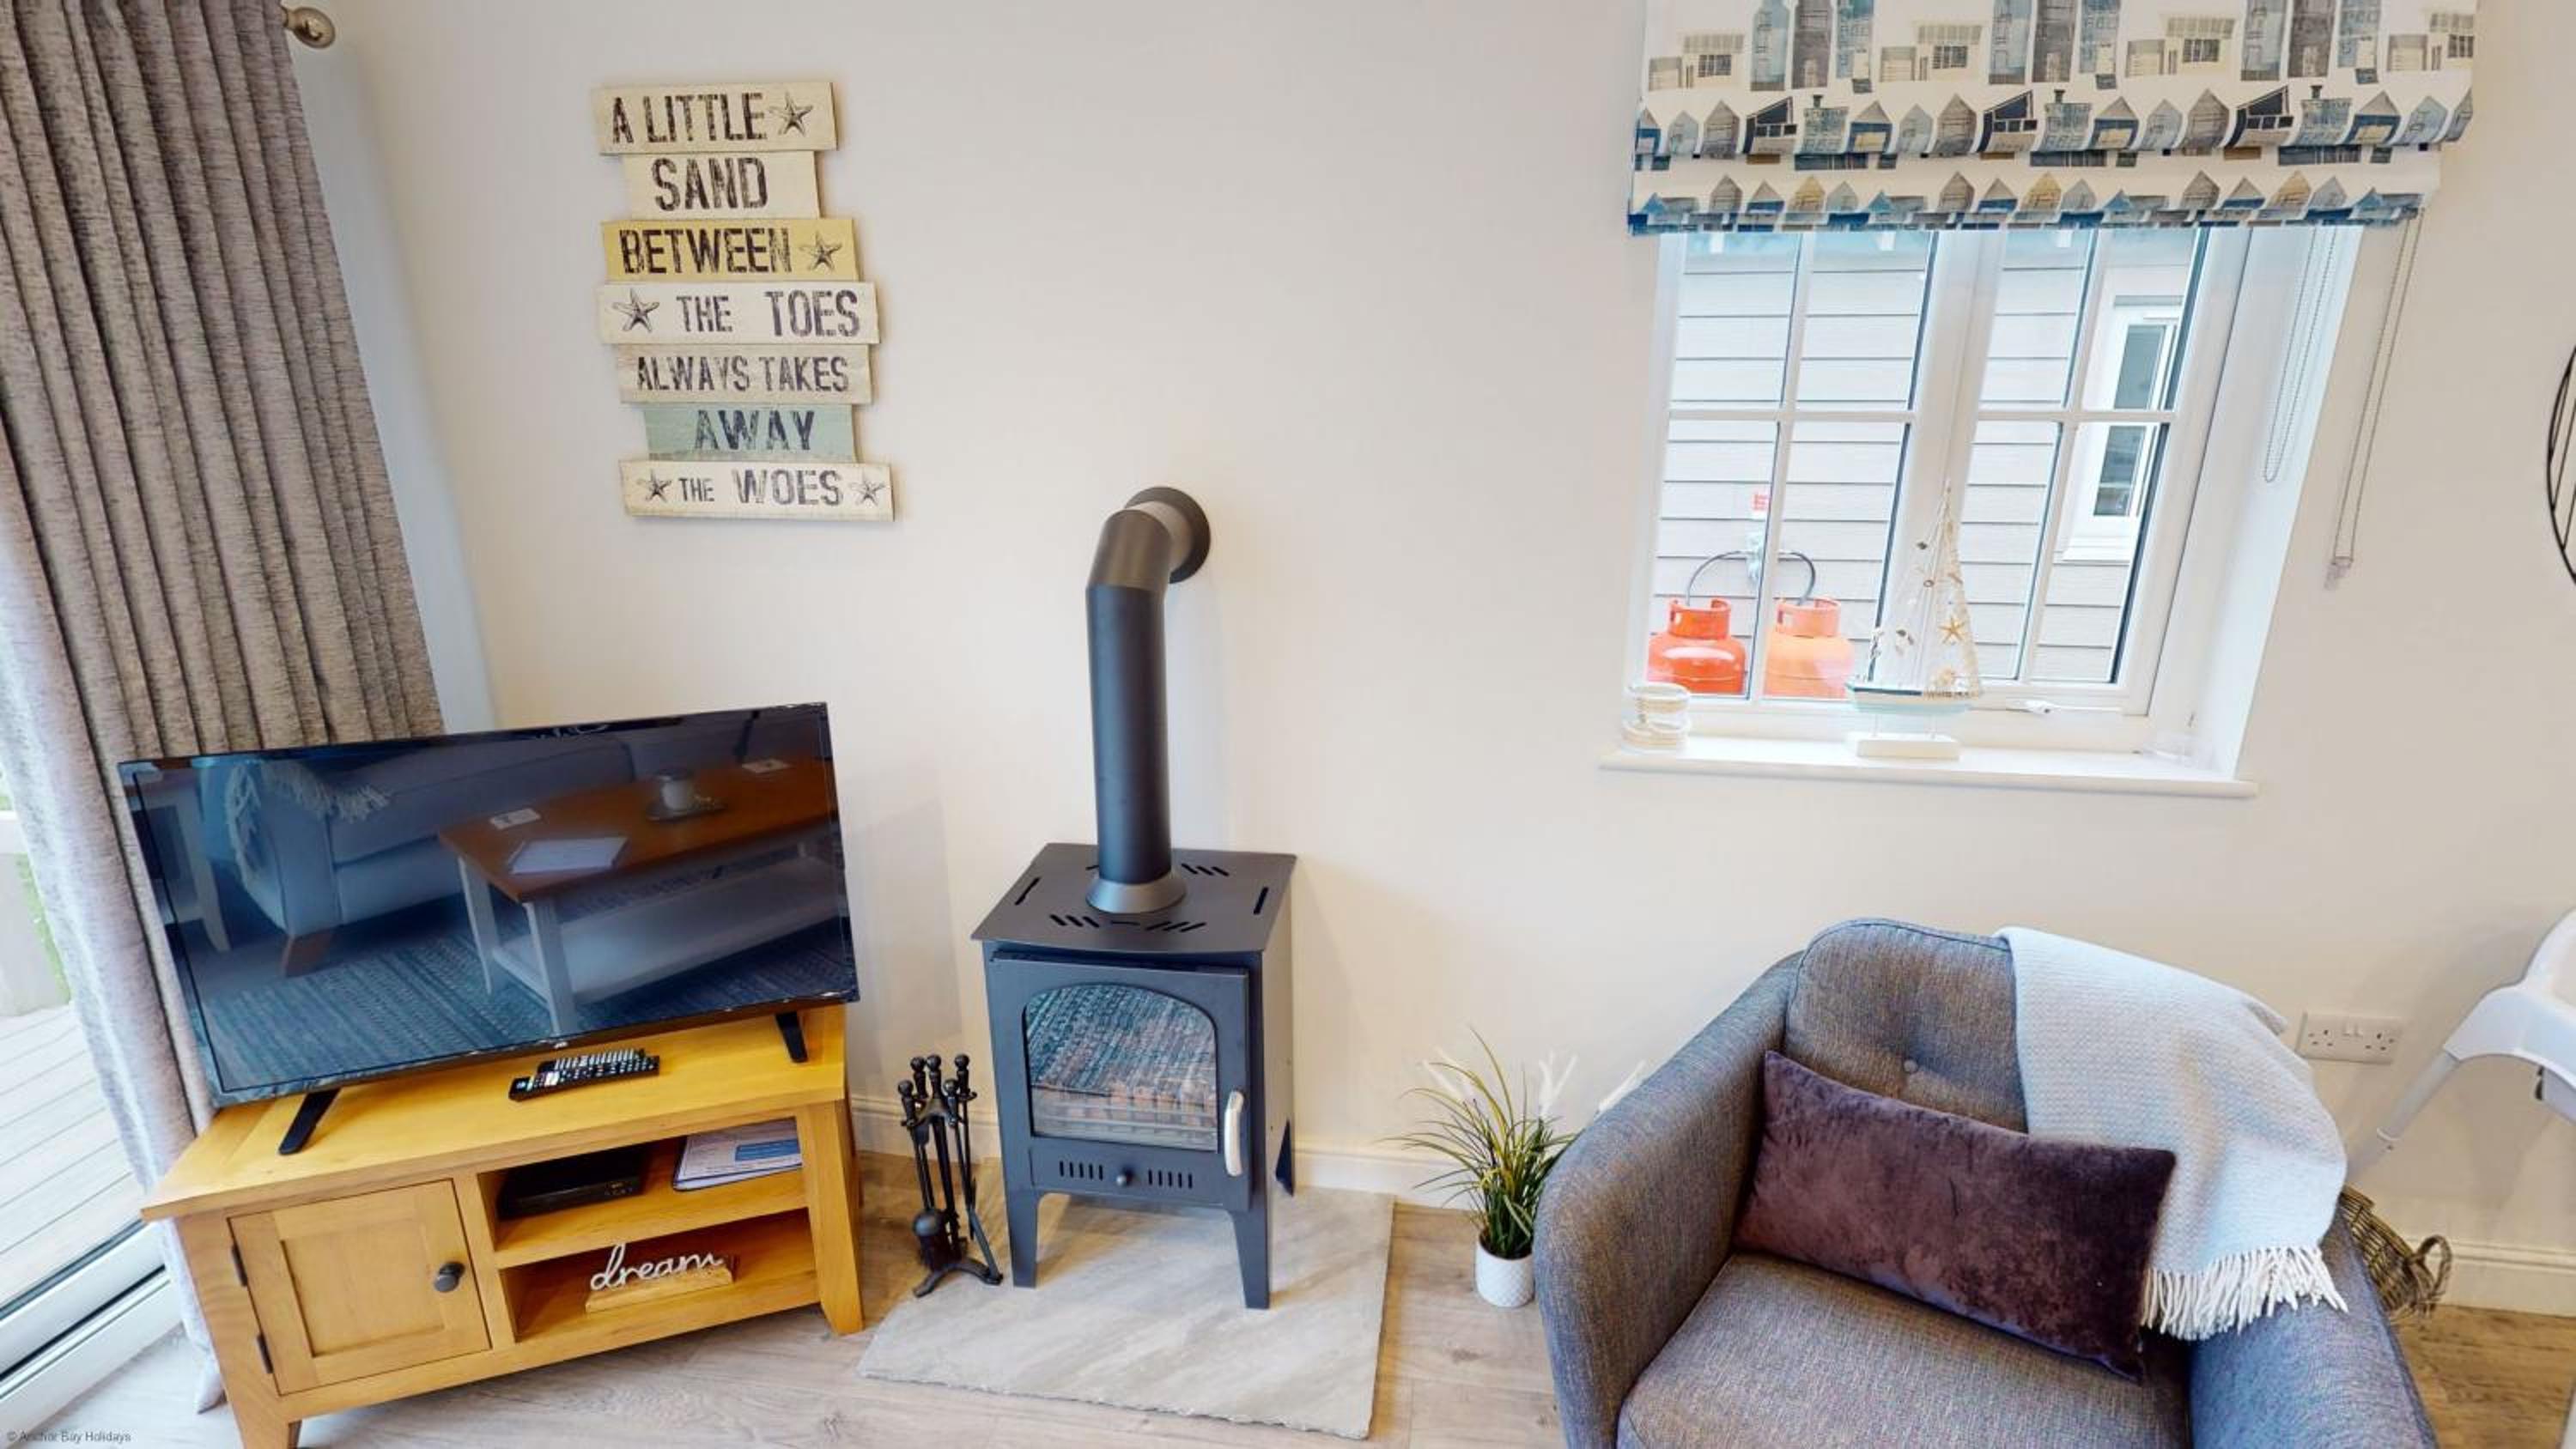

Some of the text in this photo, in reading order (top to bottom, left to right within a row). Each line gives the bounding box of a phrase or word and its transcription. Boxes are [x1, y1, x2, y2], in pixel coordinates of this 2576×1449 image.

[612, 93, 768, 144] A LITTLE
[651, 157, 769, 212] SAND
[619, 227, 793, 274] BETWEEN
[677, 289, 860, 337] THE TOES
[636, 355, 849, 392] ALWAYS TAKES
[694, 409, 815, 451] AWAY
[678, 469, 843, 506] THE WOES
[590, 1241, 724, 1291] dream
